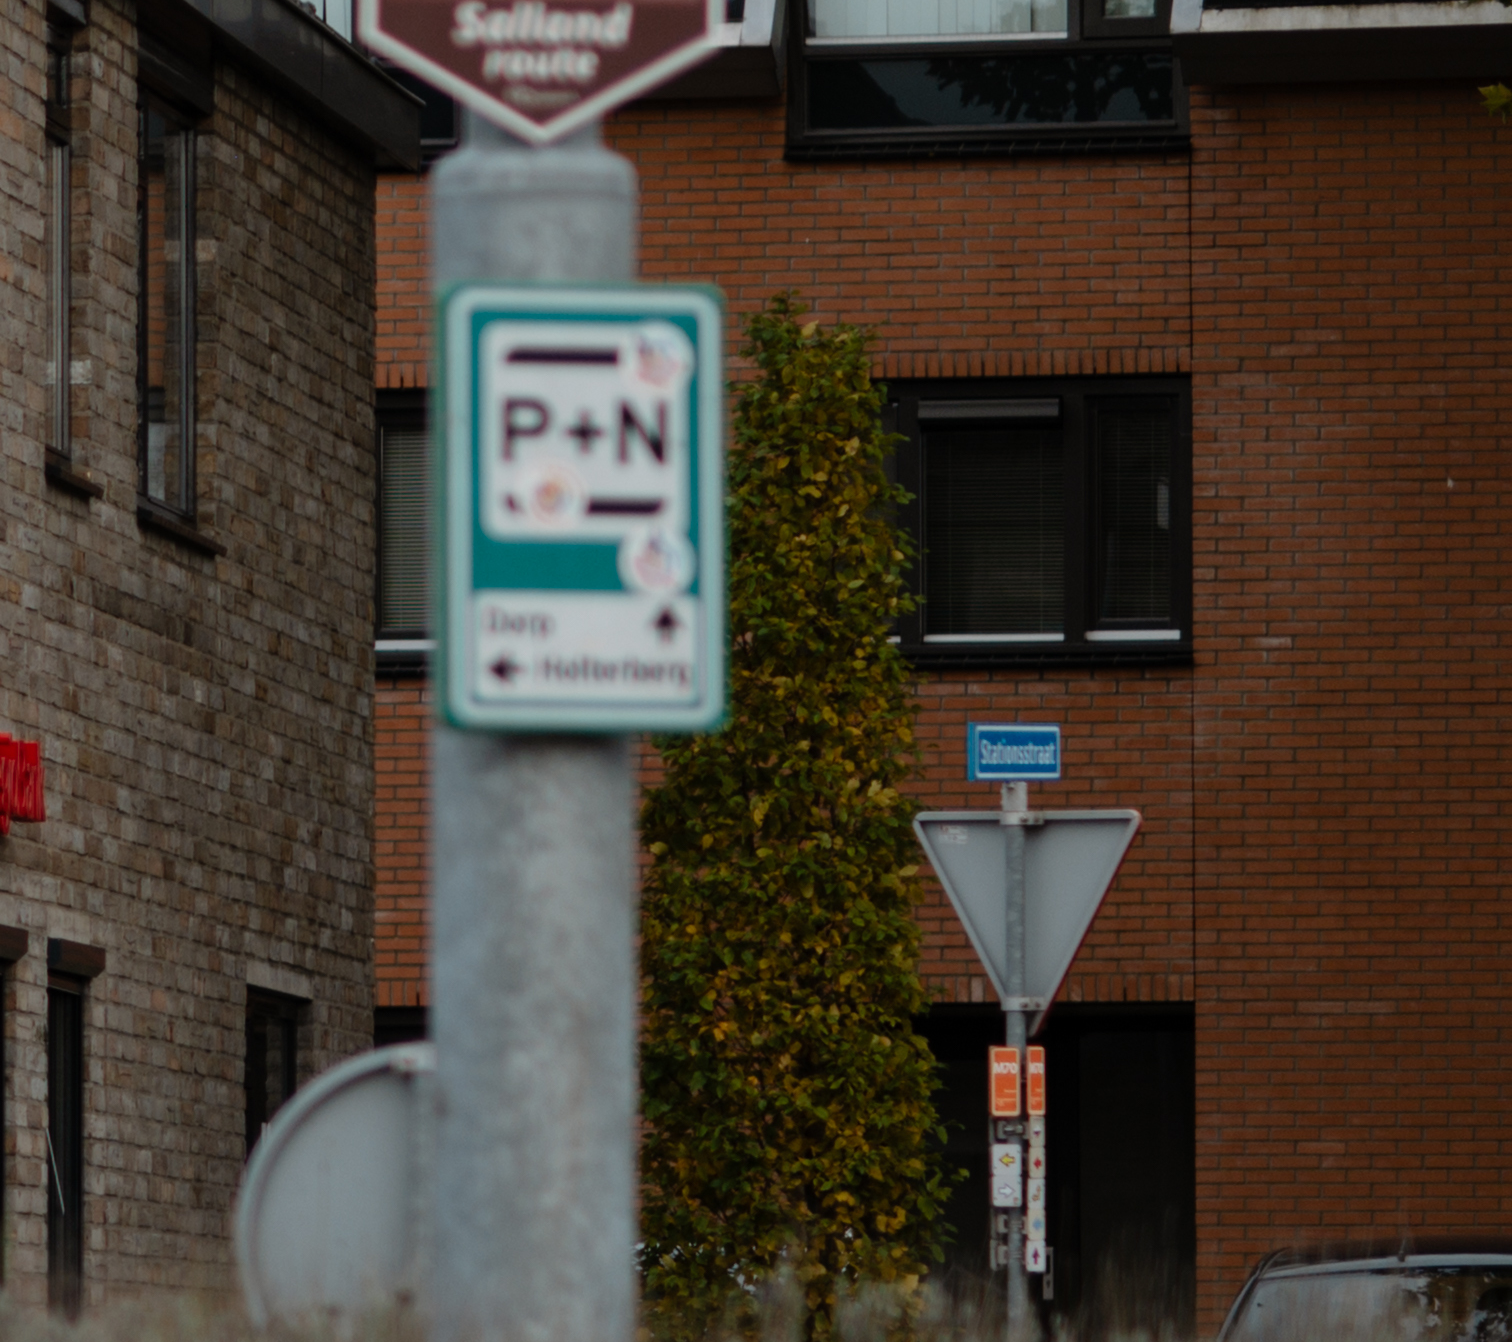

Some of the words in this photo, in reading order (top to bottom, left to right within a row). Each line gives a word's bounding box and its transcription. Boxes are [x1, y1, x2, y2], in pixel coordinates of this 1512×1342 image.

[451, 0, 634, 48] Salland
[482, 47, 600, 83] route
[501, 397, 668, 464] P+N
[980, 738, 1056, 765] Stationsstraat
